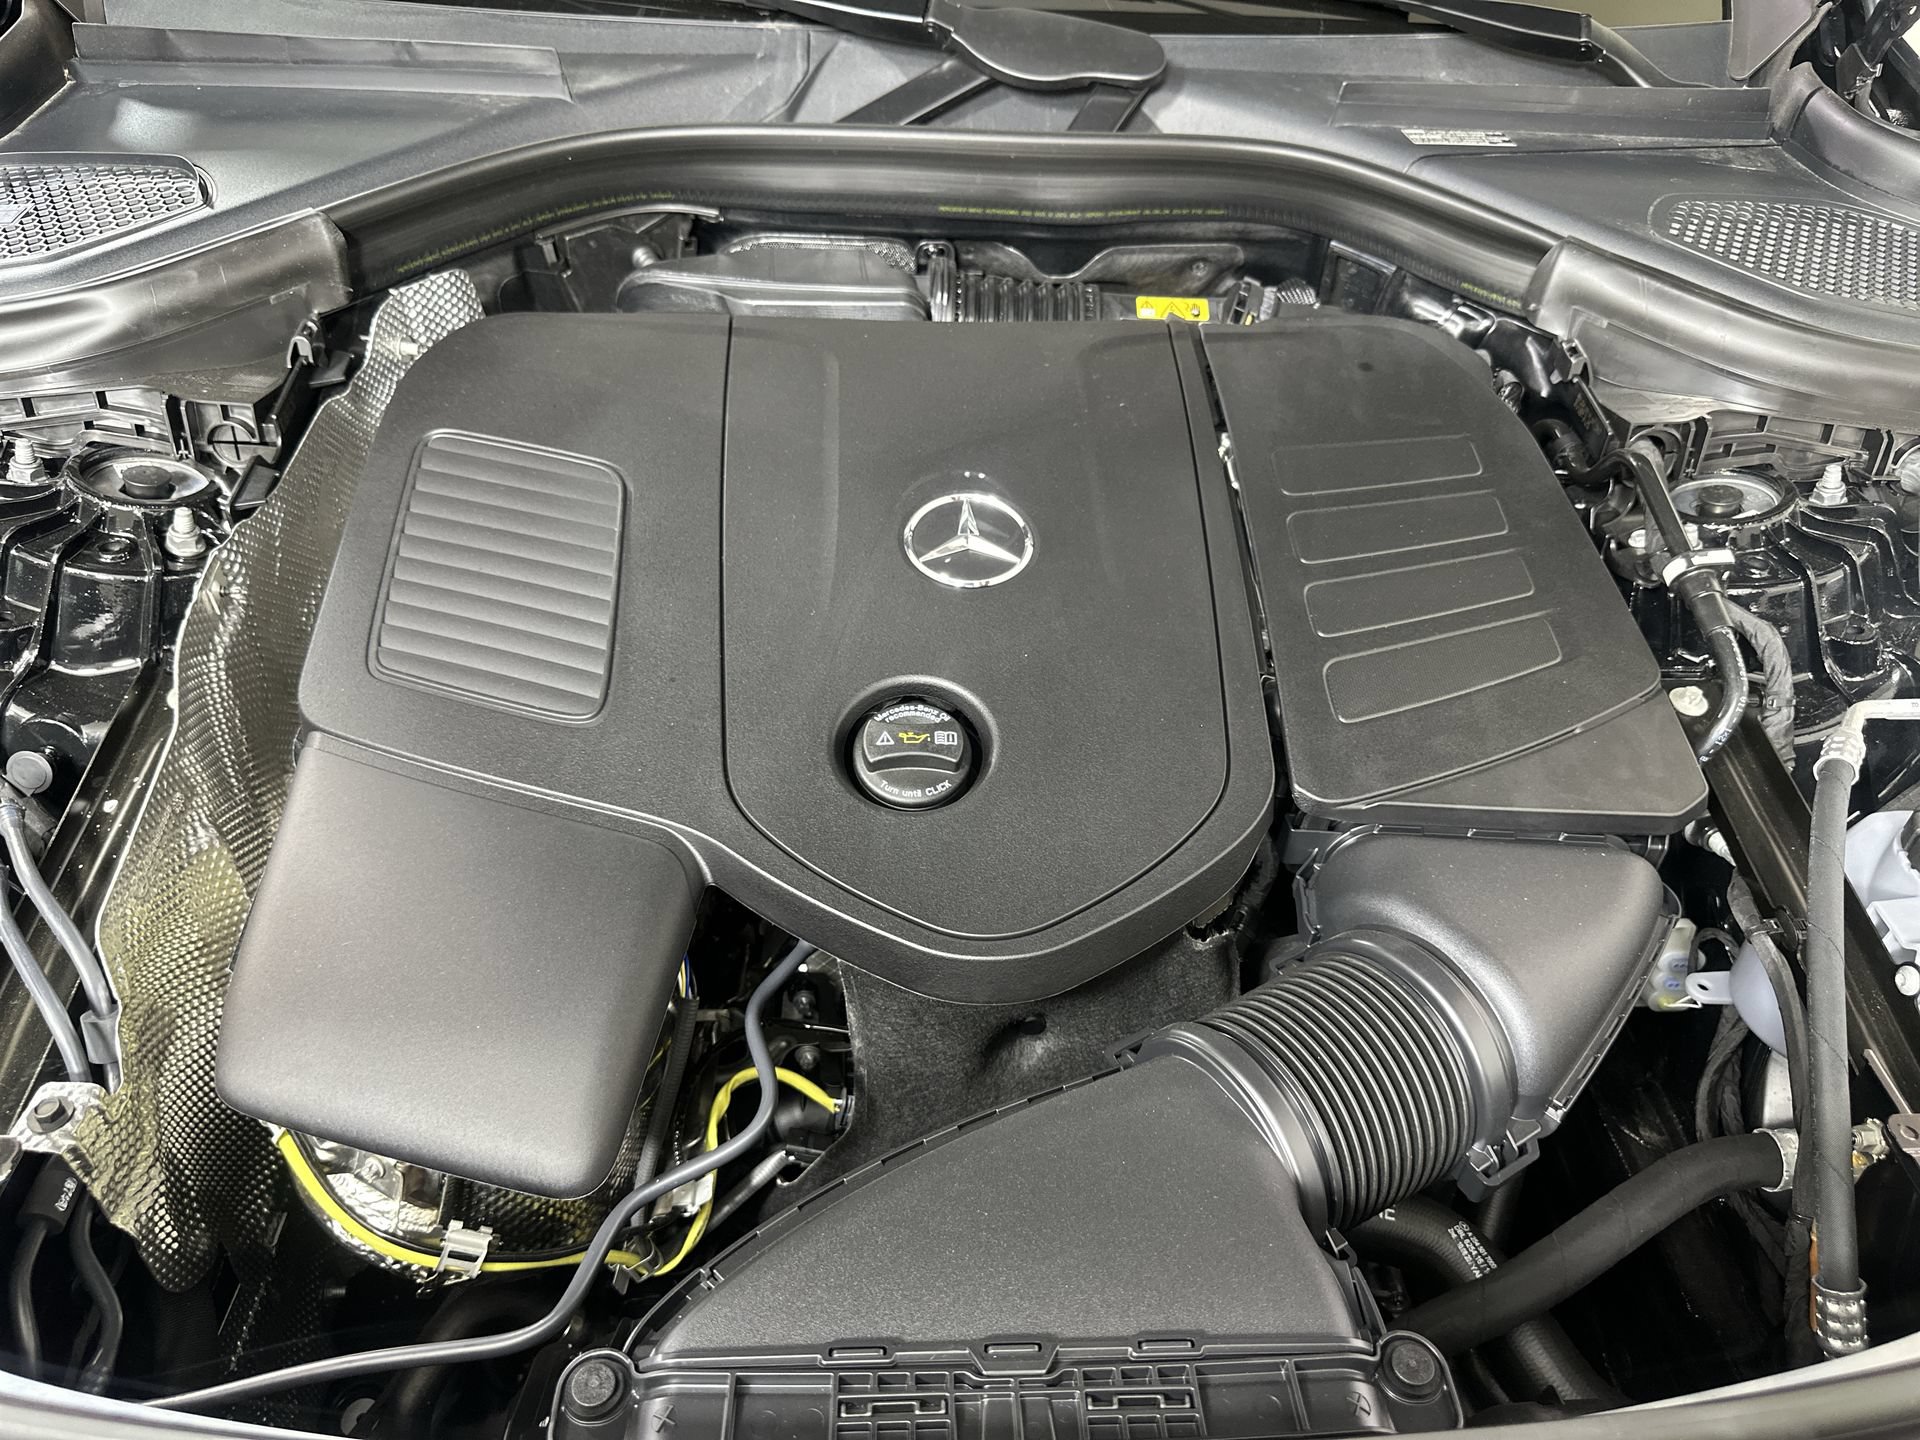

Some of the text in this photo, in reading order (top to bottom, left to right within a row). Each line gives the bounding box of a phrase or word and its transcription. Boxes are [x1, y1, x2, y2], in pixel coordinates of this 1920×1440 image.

[874, 704, 951, 722] Mercedes-Benz Oil
[885, 711, 941, 723] recommended
[880, 779, 952, 798] Turn until CLICK
